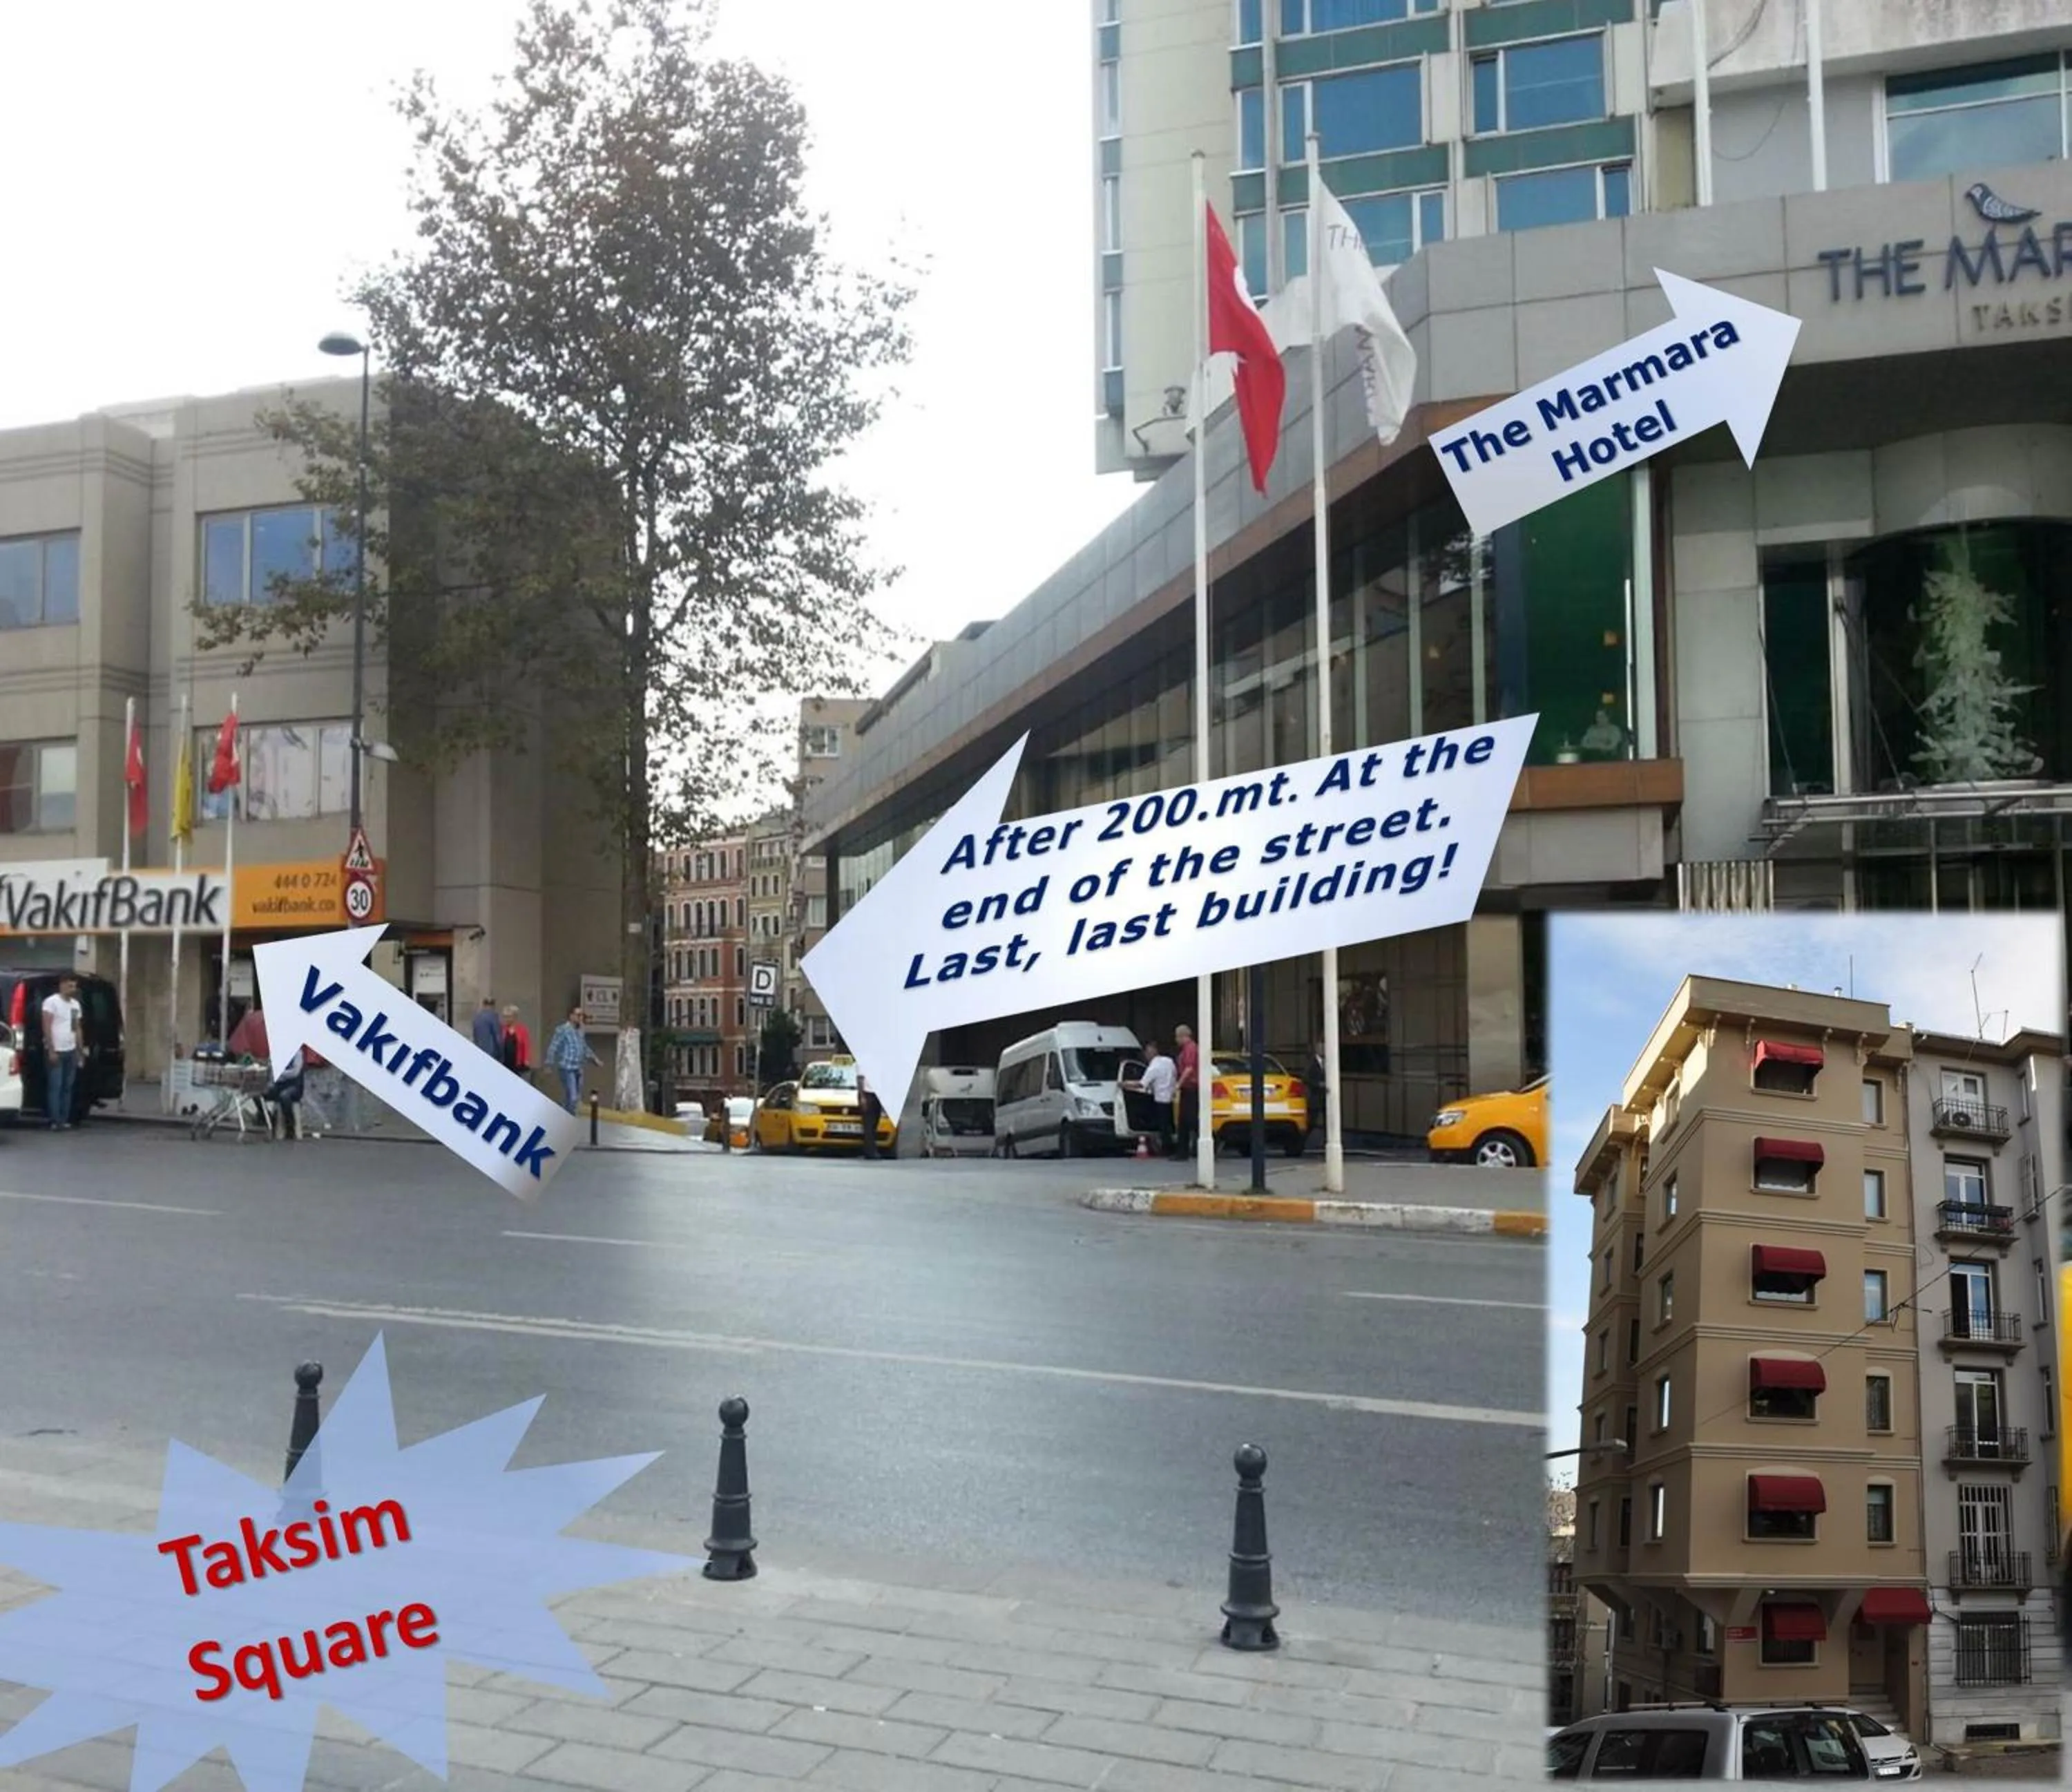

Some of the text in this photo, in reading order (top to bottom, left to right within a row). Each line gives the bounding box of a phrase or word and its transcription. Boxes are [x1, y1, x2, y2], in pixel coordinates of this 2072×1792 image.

[1327, 224, 1363, 250] TH
[1818, 239, 1926, 302] THE
[350, 888, 368, 911] 30
[756, 969, 771, 989] D
